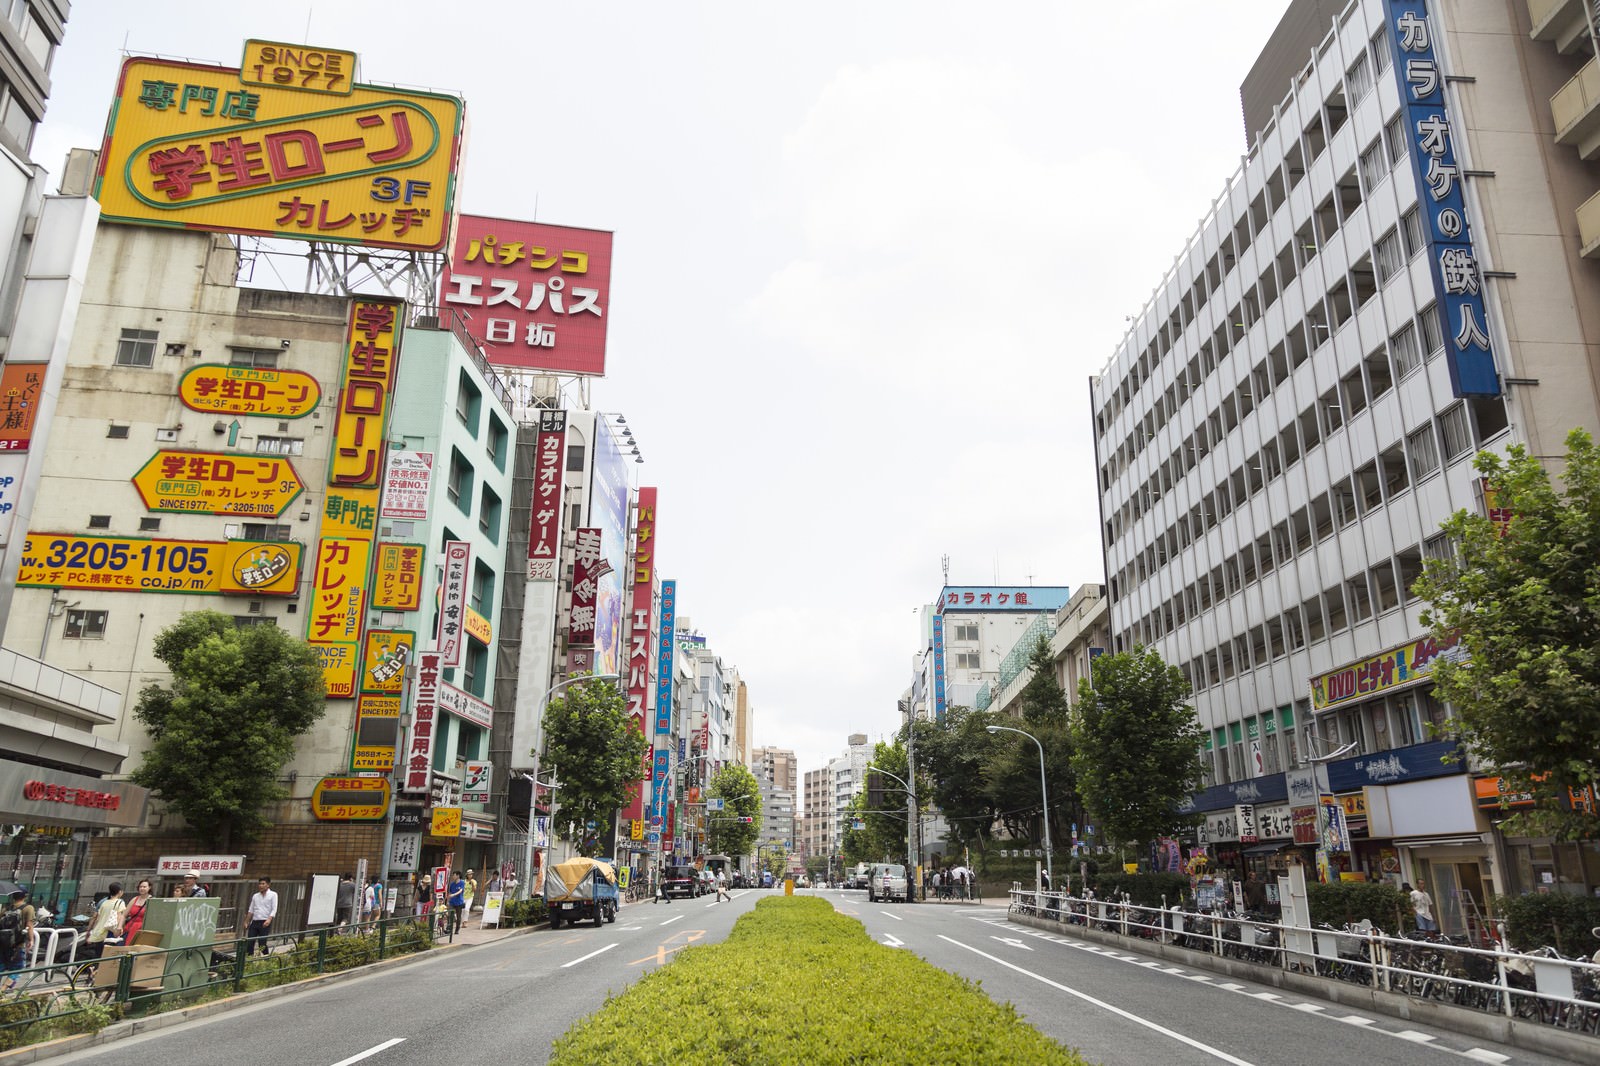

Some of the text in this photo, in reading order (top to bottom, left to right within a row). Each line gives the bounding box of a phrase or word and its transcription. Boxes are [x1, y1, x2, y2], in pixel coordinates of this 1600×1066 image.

[259, 45, 343, 73] SINCE
[253, 64, 345, 90] 1977
[138, 79, 261, 121] 専門店
[148, 111, 414, 200] 学生ローン
[370, 177, 431, 204] 3F
[1398, 11, 1490, 351] カラオケの鉄人
[276, 196, 431, 237] カレッヂ
[464, 234, 588, 273] パチンコ
[445, 274, 602, 317] エスパス
[487, 318, 556, 347] 日拓
[231, 369, 275, 381] 専門店
[195, 377, 309, 403] 学生ローン
[336, 303, 393, 483] 学生ローン
[542, 422, 563, 431] ビル
[161, 456, 280, 484] 学生ローン
[159, 481, 197, 494] 専門店
[279, 481, 296, 493] 3F
[325, 495, 375, 531] 専門店
[453, 549, 465, 558] 2F
[636, 506, 654, 583] パチンコ
[140, 577, 213, 590] co.jp/m/
[398, 548, 418, 605] 学生ローン
[530, 570, 552, 579] タイム
[315, 541, 350, 637] カレッヂ
[948, 592, 1028, 605] カラオケ館
[628, 609, 648, 718] エスパス
[330, 683, 350, 693] 1105
[406, 655, 440, 788] 東京三協信用金庫
[323, 780, 384, 789] 学生ローン
[162, 861, 239, 870] 東京三協信用金庫
